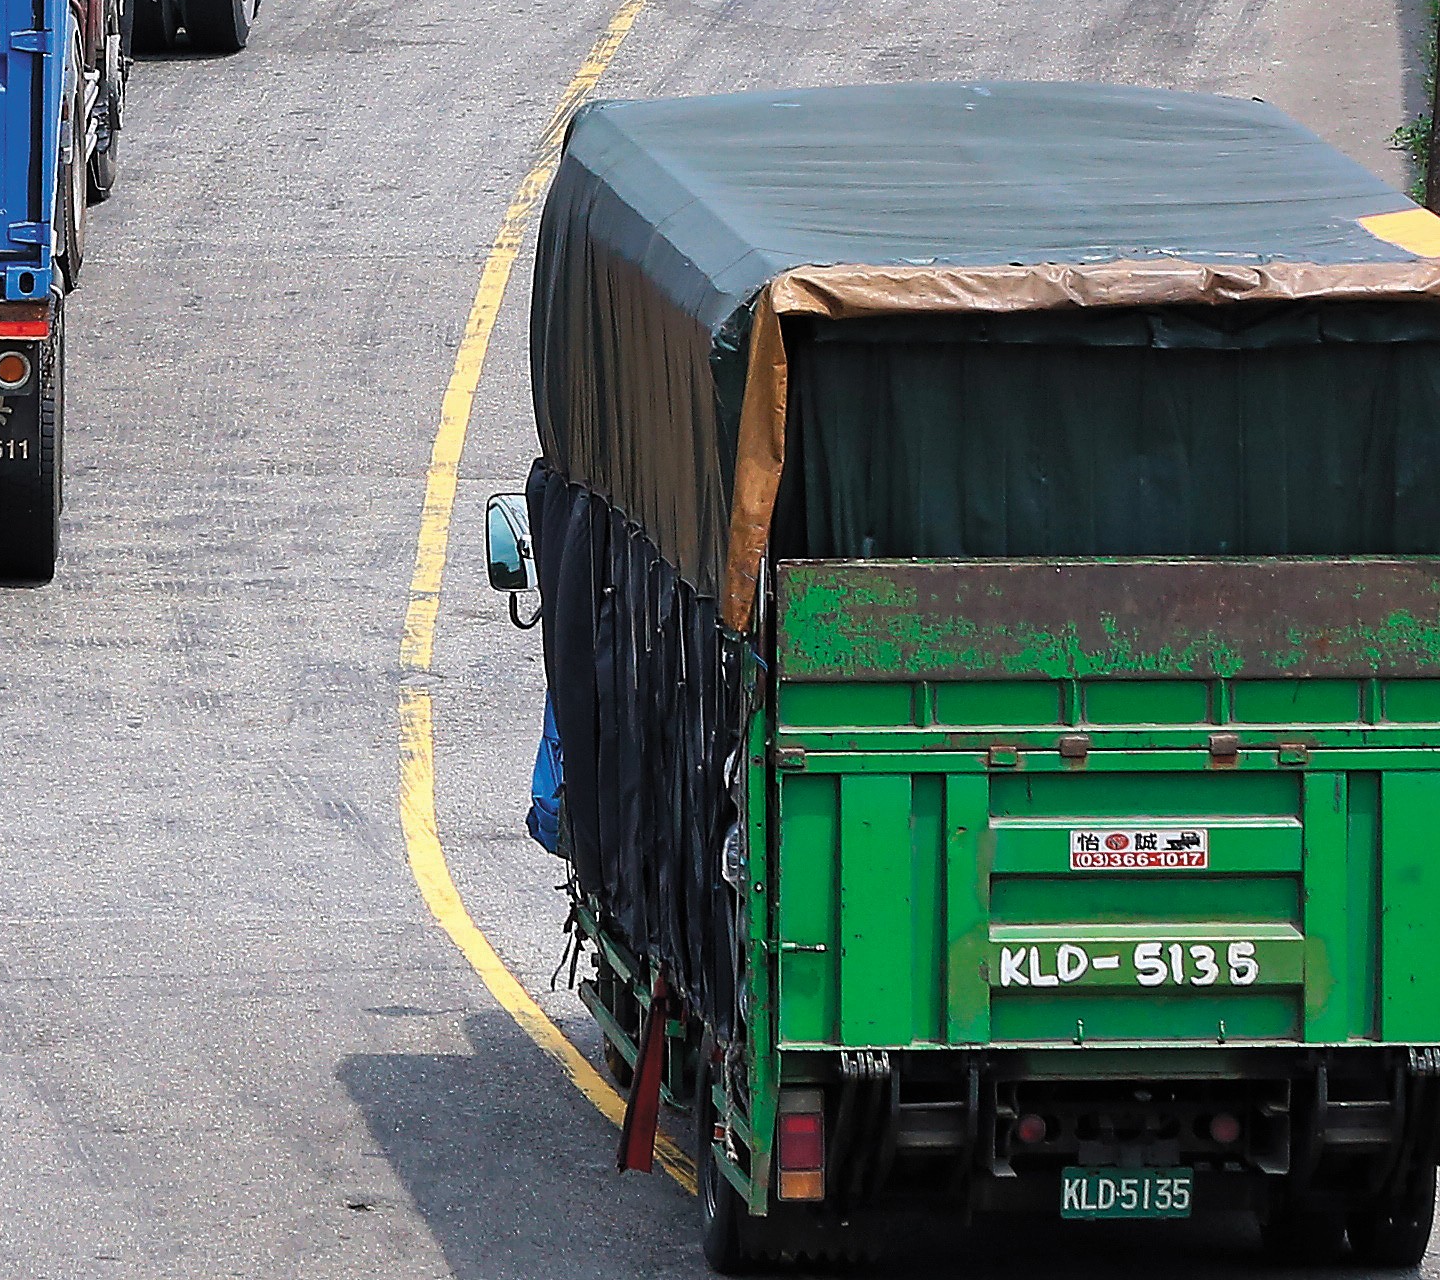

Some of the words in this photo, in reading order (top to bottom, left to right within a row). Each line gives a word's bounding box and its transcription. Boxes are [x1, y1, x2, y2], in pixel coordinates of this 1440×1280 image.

[1077, 833, 1100, 851] 怡
[1134, 833, 1157, 851] 誠
[1076, 853, 1202, 867] (03)366-1017
[1000, 942, 1259, 988] KLD-5135
[1063, 1177, 1192, 1210] KLD-5135
